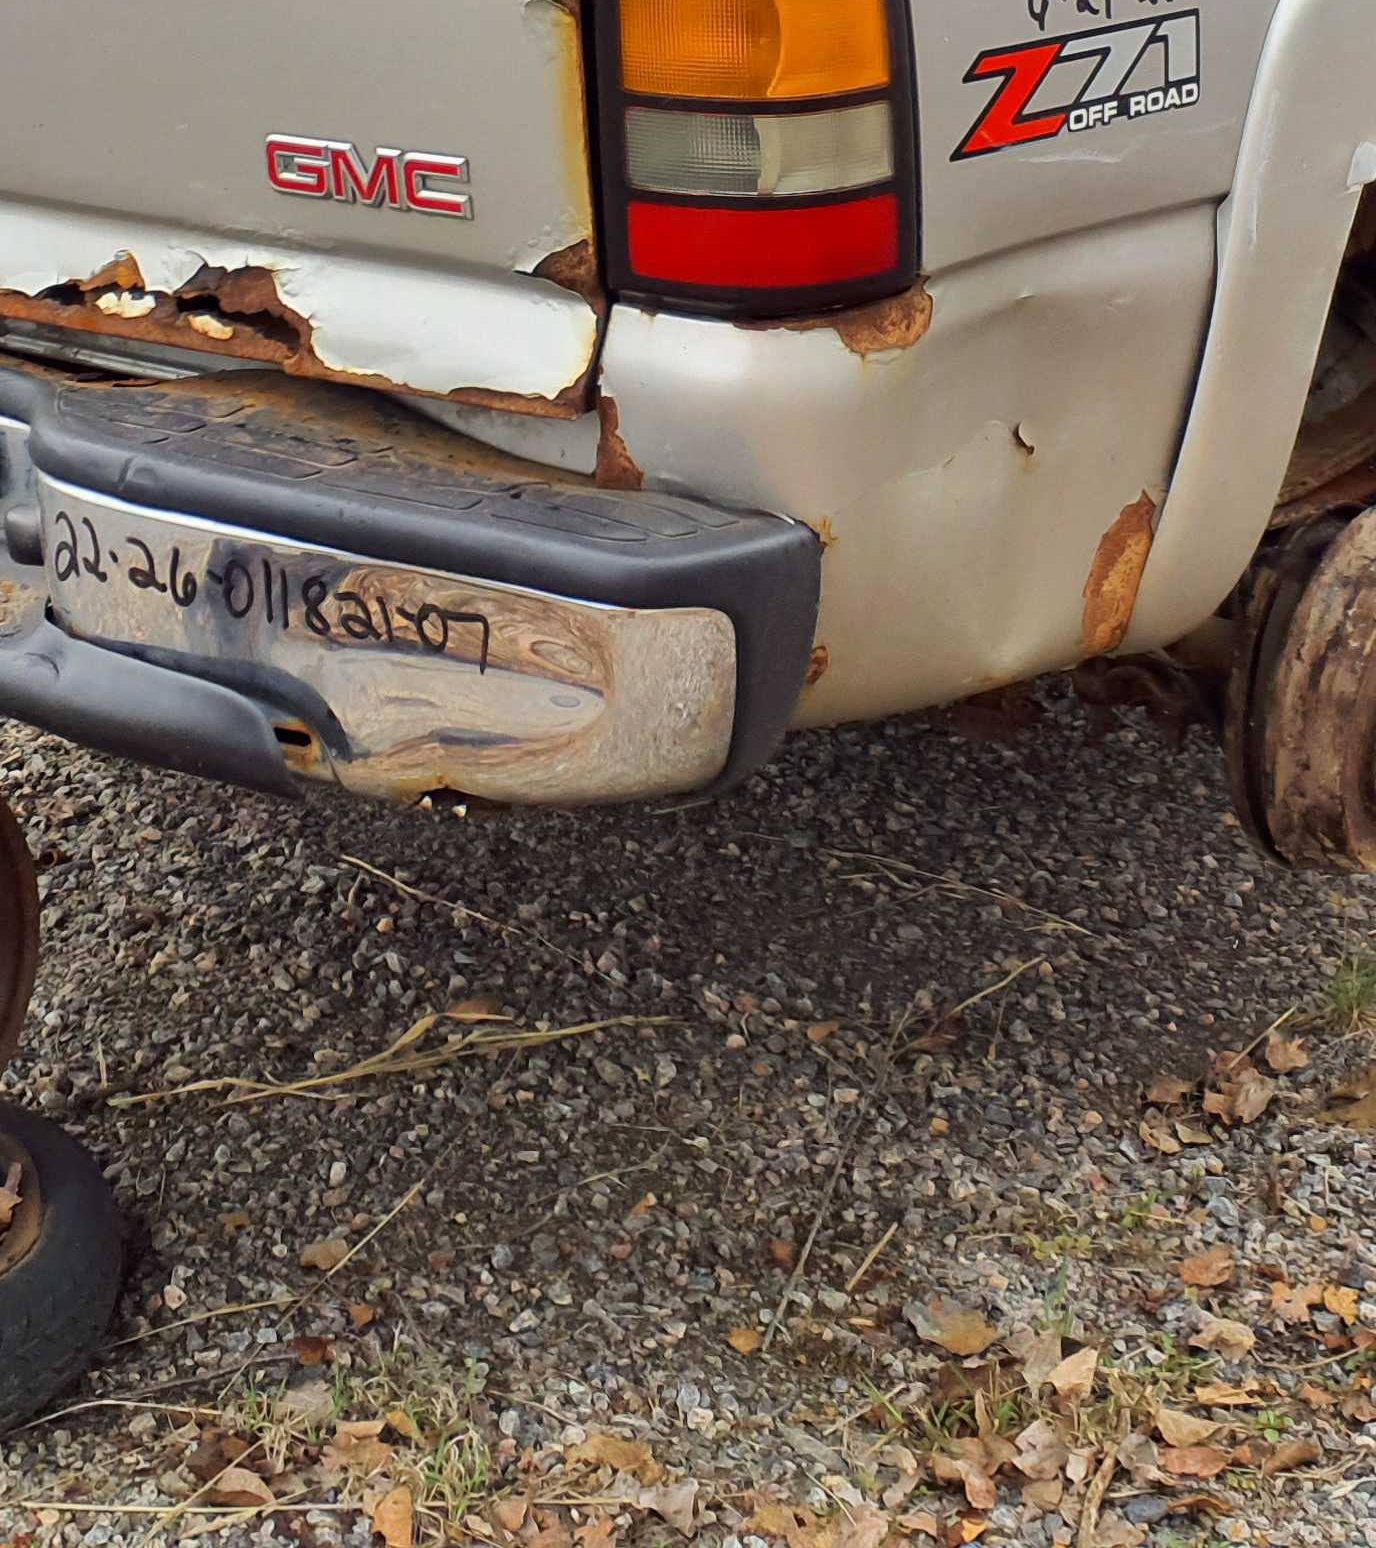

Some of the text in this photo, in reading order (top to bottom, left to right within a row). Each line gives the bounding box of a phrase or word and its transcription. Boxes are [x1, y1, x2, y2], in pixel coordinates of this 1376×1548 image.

[949, 7, 1201, 163] Z71
[1067, 82, 1200, 133] OFF ROAD
[264, 132, 474, 221] GMC
